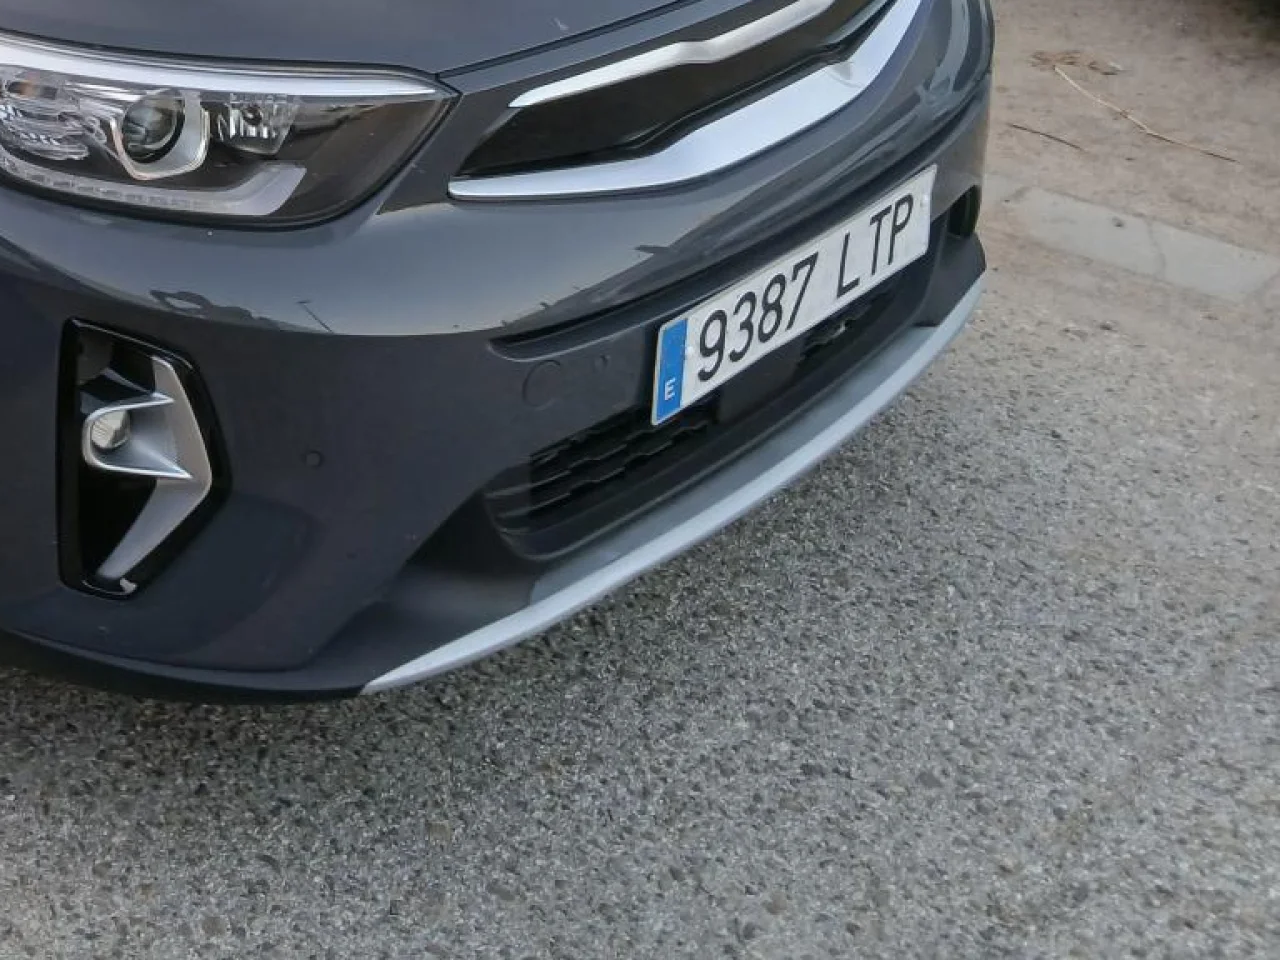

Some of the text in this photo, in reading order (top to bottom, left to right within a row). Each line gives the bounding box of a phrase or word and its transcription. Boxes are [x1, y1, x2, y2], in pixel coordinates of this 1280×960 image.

[697, 193, 914, 382] 9387 LTP
[664, 377, 676, 401] E
